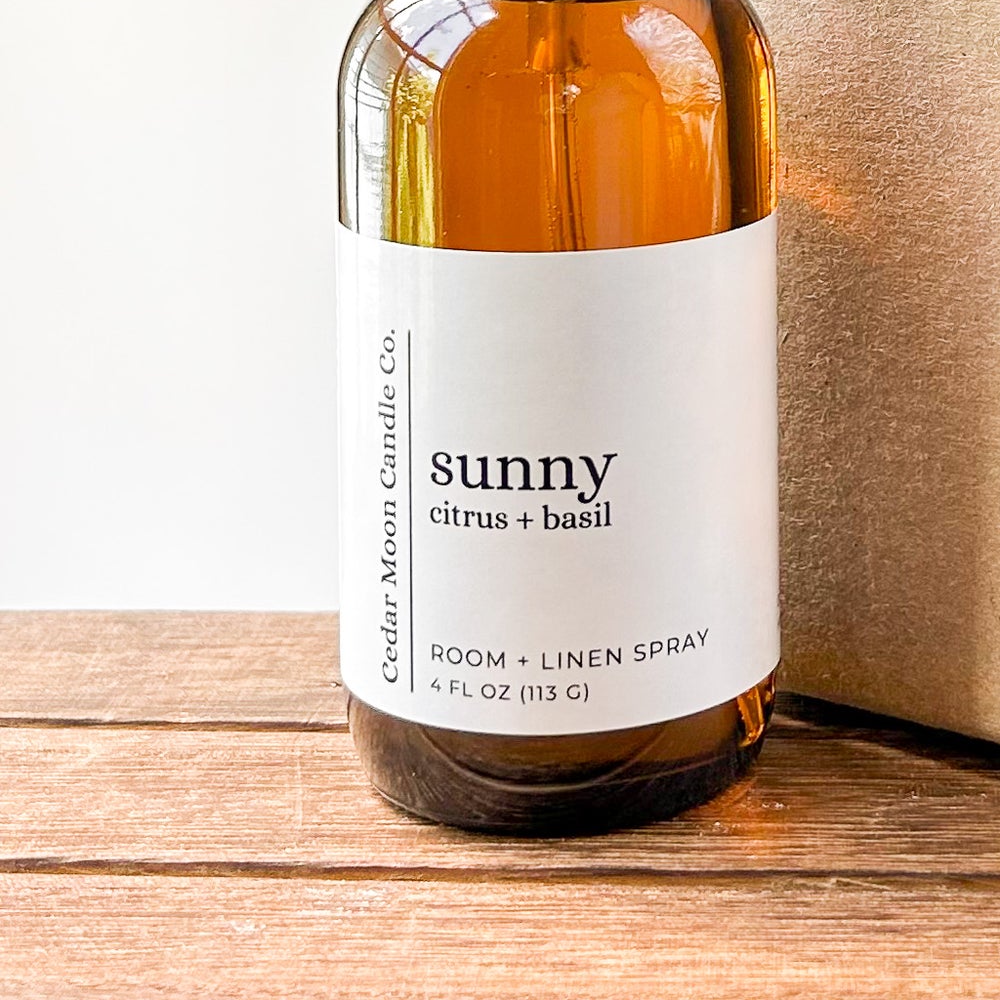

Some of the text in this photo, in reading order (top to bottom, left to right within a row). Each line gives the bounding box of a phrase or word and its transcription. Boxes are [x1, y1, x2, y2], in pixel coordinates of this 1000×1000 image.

[430, 451, 619, 505] sunny
[377, 328, 399, 684] Cedar Moon Candle Co.
[429, 499, 613, 531] citrus + basil
[431, 627, 710, 671] ROOM + LINEN SPRAY
[430, 677, 590, 706] 4 FL OZ (113 G)
